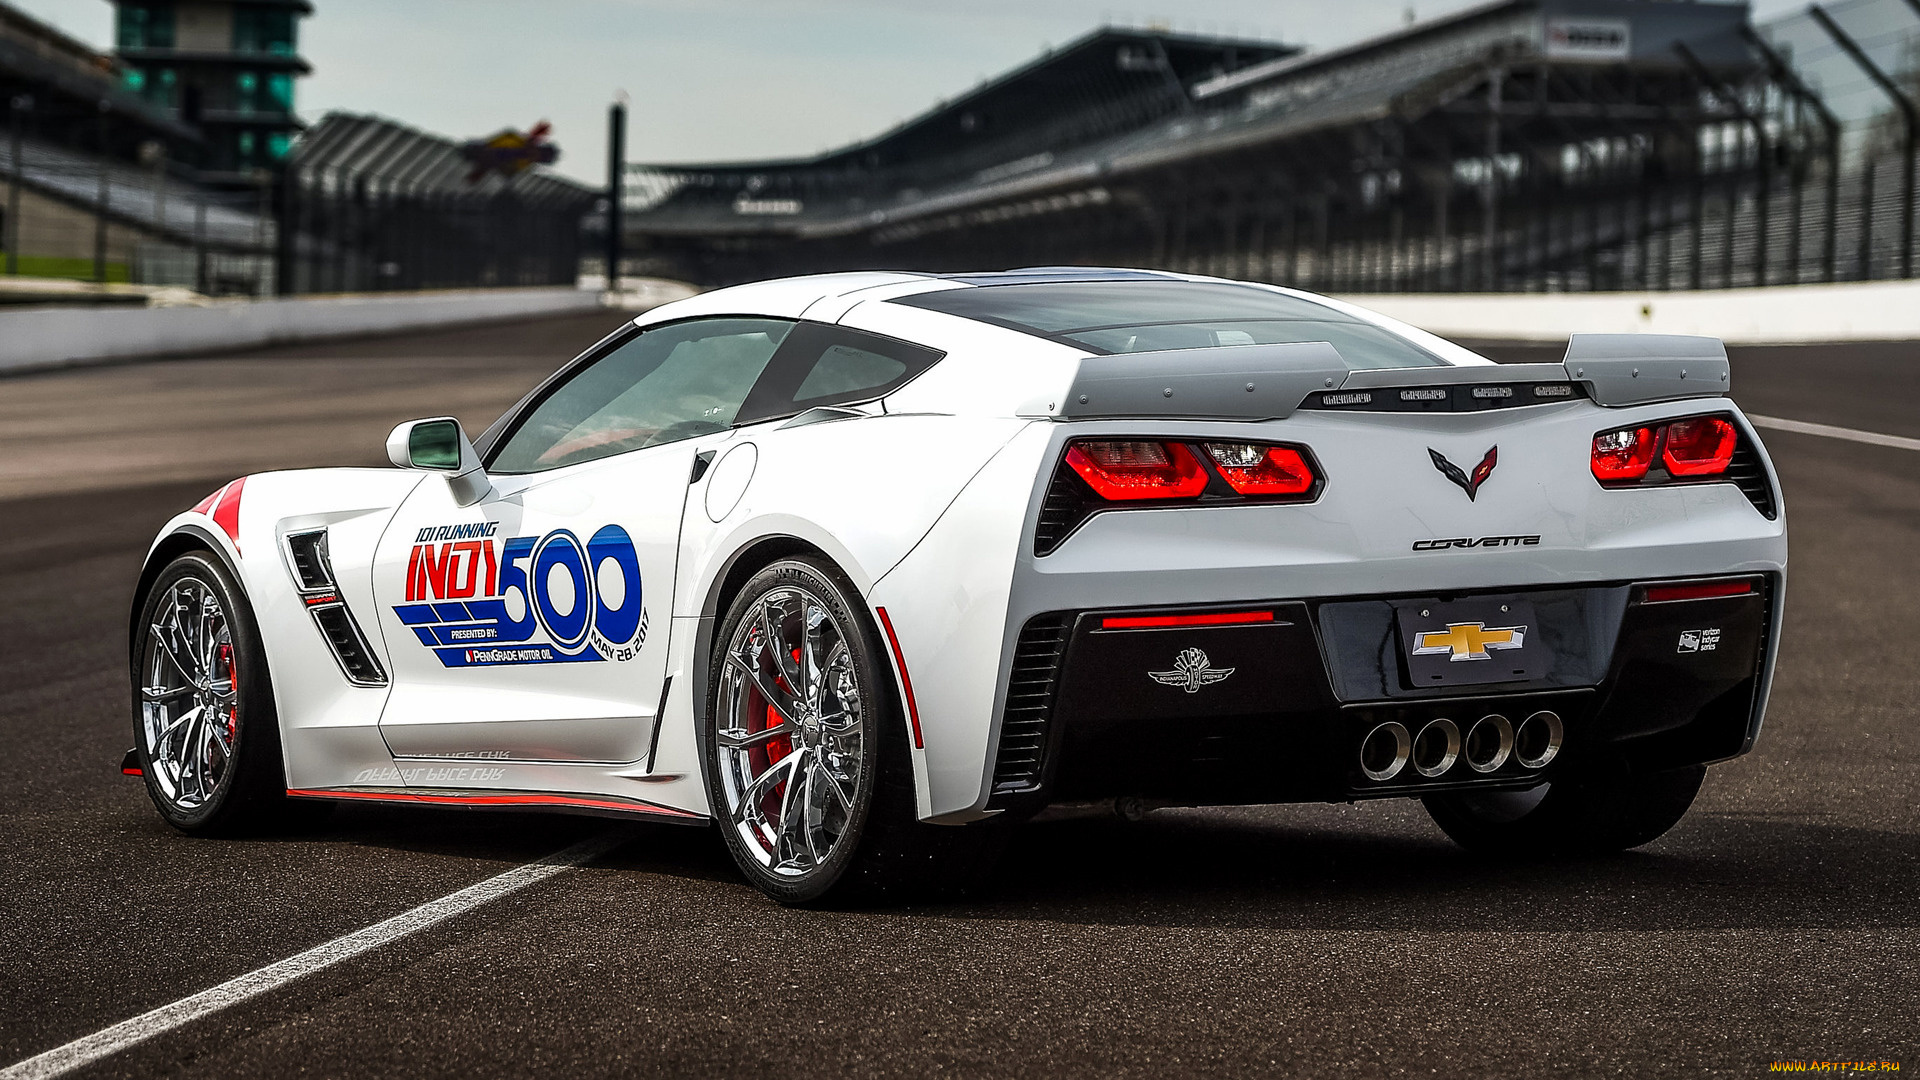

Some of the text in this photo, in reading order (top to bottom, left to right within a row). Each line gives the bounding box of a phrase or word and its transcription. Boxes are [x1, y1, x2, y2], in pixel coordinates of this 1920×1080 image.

[415, 521, 499, 543] 101 RUNNING
[1412, 534, 1541, 550] CORVETTE
[405, 523, 642, 655] INDY 500
[800, 572, 834, 603] MICHELIN
[451, 628, 498, 639] PRESENTED BY:
[591, 629, 615, 659] MAY
[517, 649, 541, 660] MOTOR
[541, 648, 554, 659] OIL
